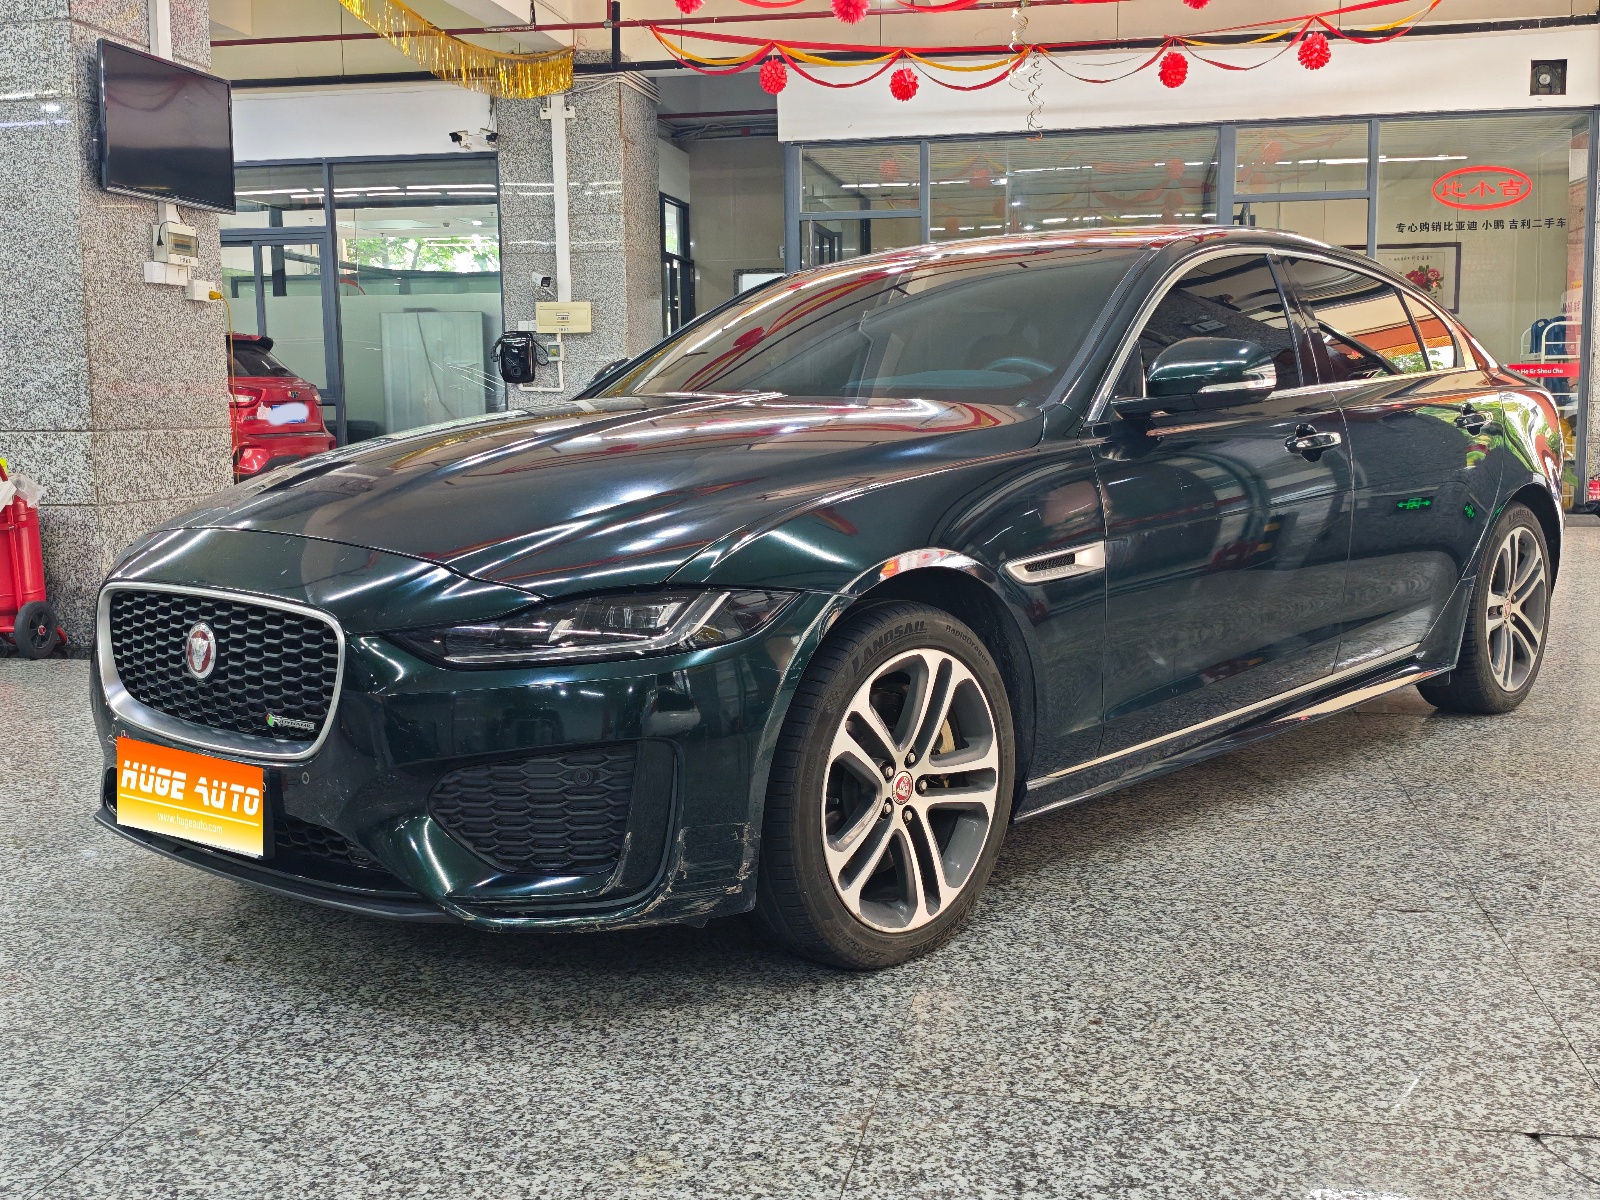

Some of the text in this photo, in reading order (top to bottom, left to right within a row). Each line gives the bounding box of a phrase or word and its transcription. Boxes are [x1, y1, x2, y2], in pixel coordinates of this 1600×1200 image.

[1440, 178, 1525, 199] 比小吉
[1396, 217, 1567, 233] 专心购销比亚迪 小鹏 吉利二手车
[1040, 565, 1078, 577] JAGUAR
[851, 620, 928, 677] LANDSAIL
